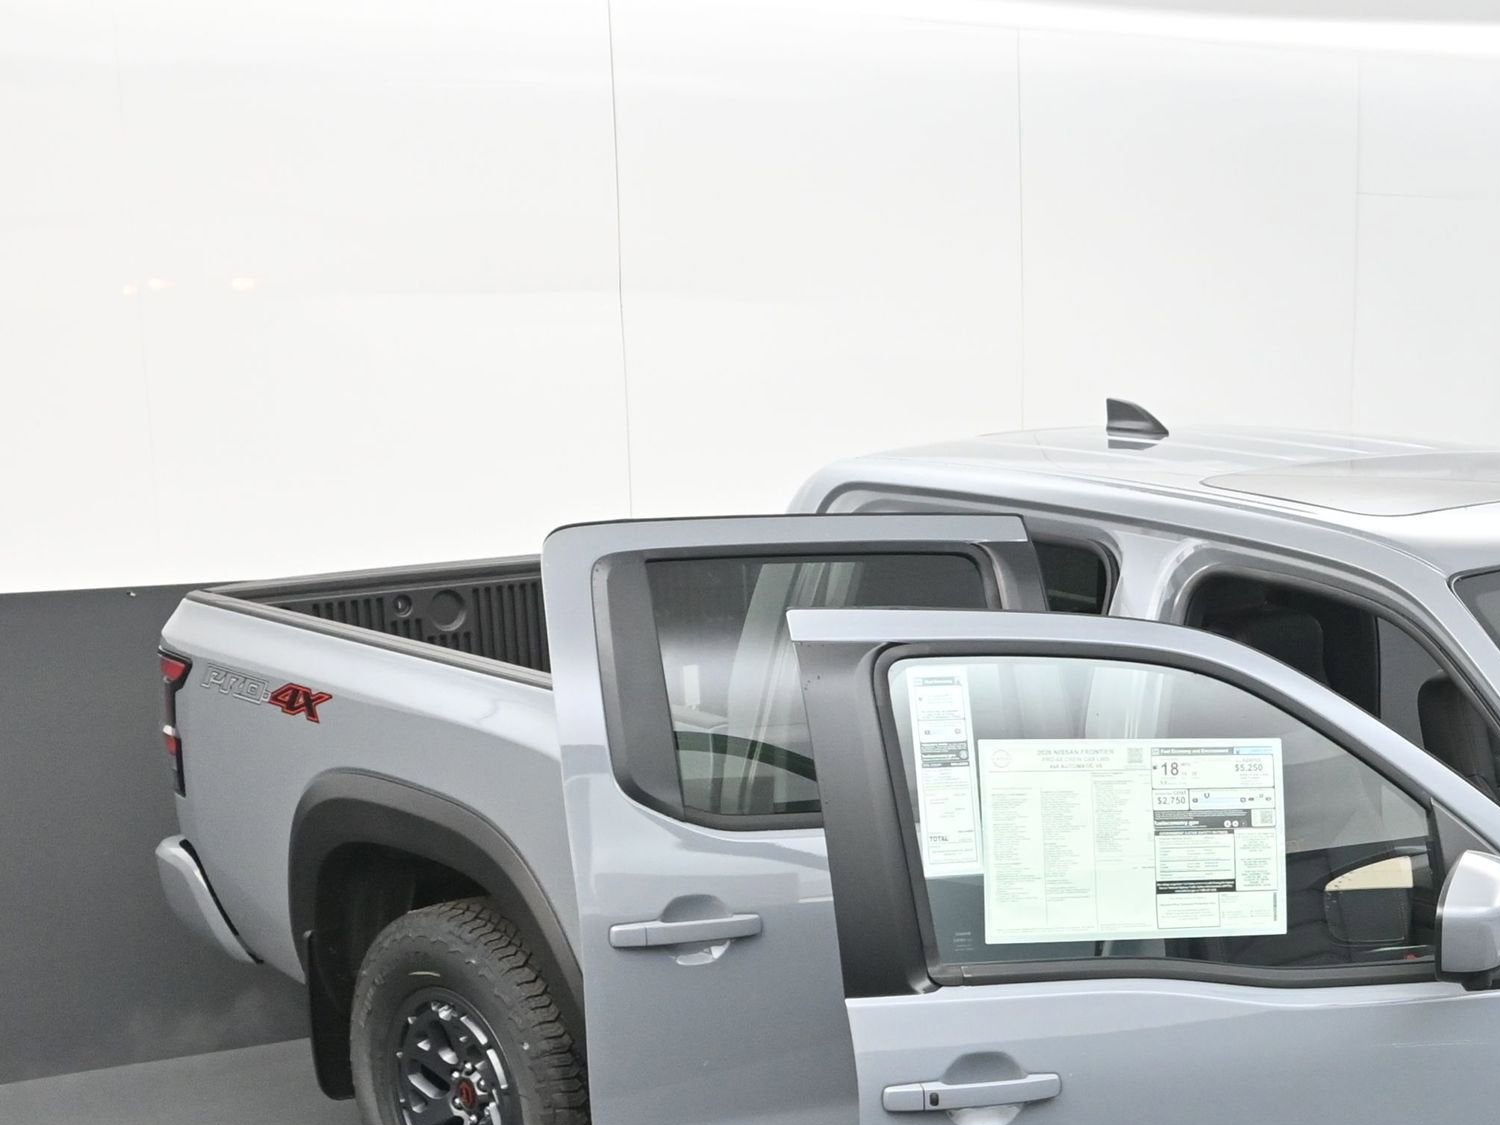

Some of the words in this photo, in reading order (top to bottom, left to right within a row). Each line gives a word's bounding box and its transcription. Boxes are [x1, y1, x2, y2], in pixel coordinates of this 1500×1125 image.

[200, 662, 333, 724] PRO-4X
[1160, 761, 1179, 776] 18
[1157, 796, 1186, 805] $2,750
